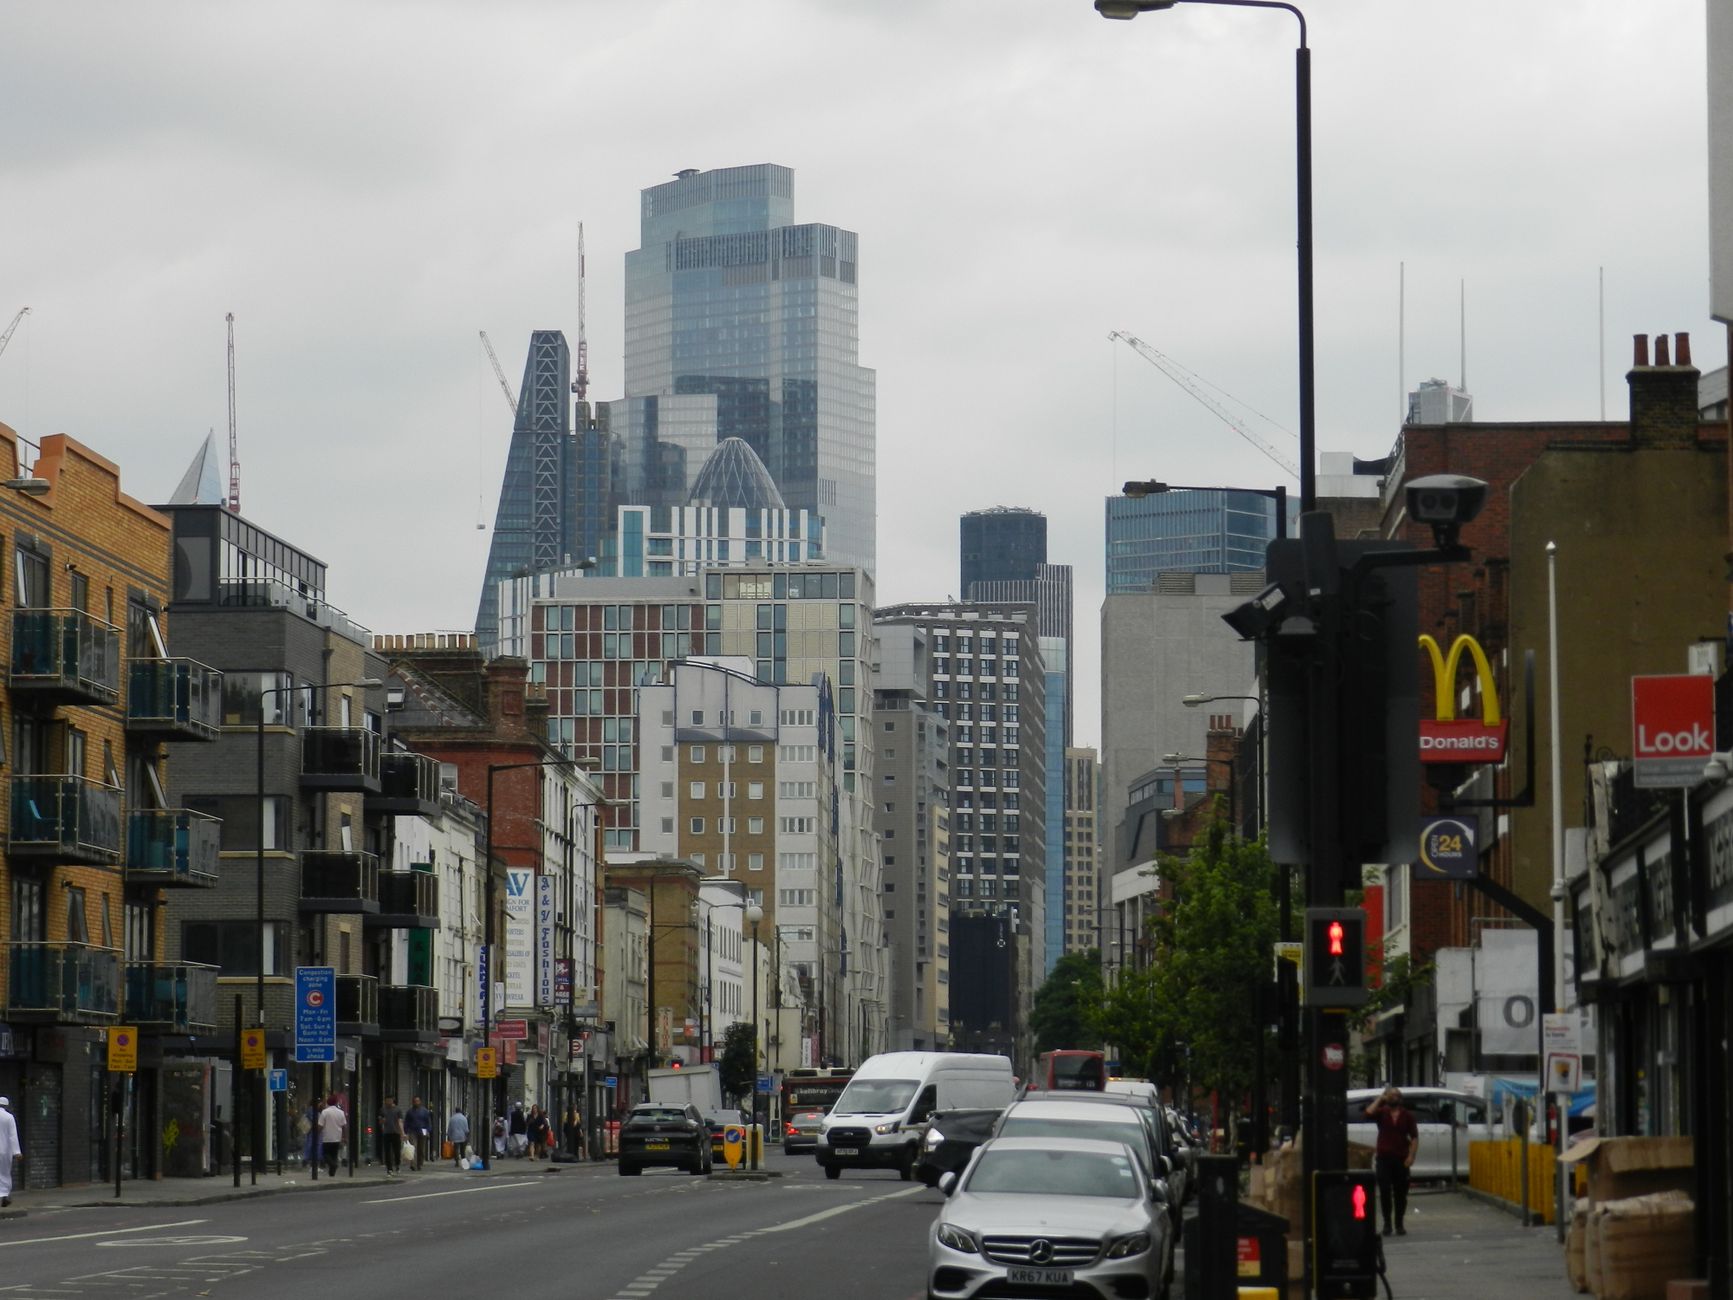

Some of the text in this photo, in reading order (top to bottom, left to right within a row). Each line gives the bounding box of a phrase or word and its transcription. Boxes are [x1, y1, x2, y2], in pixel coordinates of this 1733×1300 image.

[1419, 735, 1500, 750] Donald's
[1639, 722, 1711, 753] Look
[1431, 834, 1439, 858] OPEN
[1439, 834, 1461, 852] 24
[541, 927, 551, 1005] Fashions
[1011, 1269, 1070, 1283] KR67 KUA
